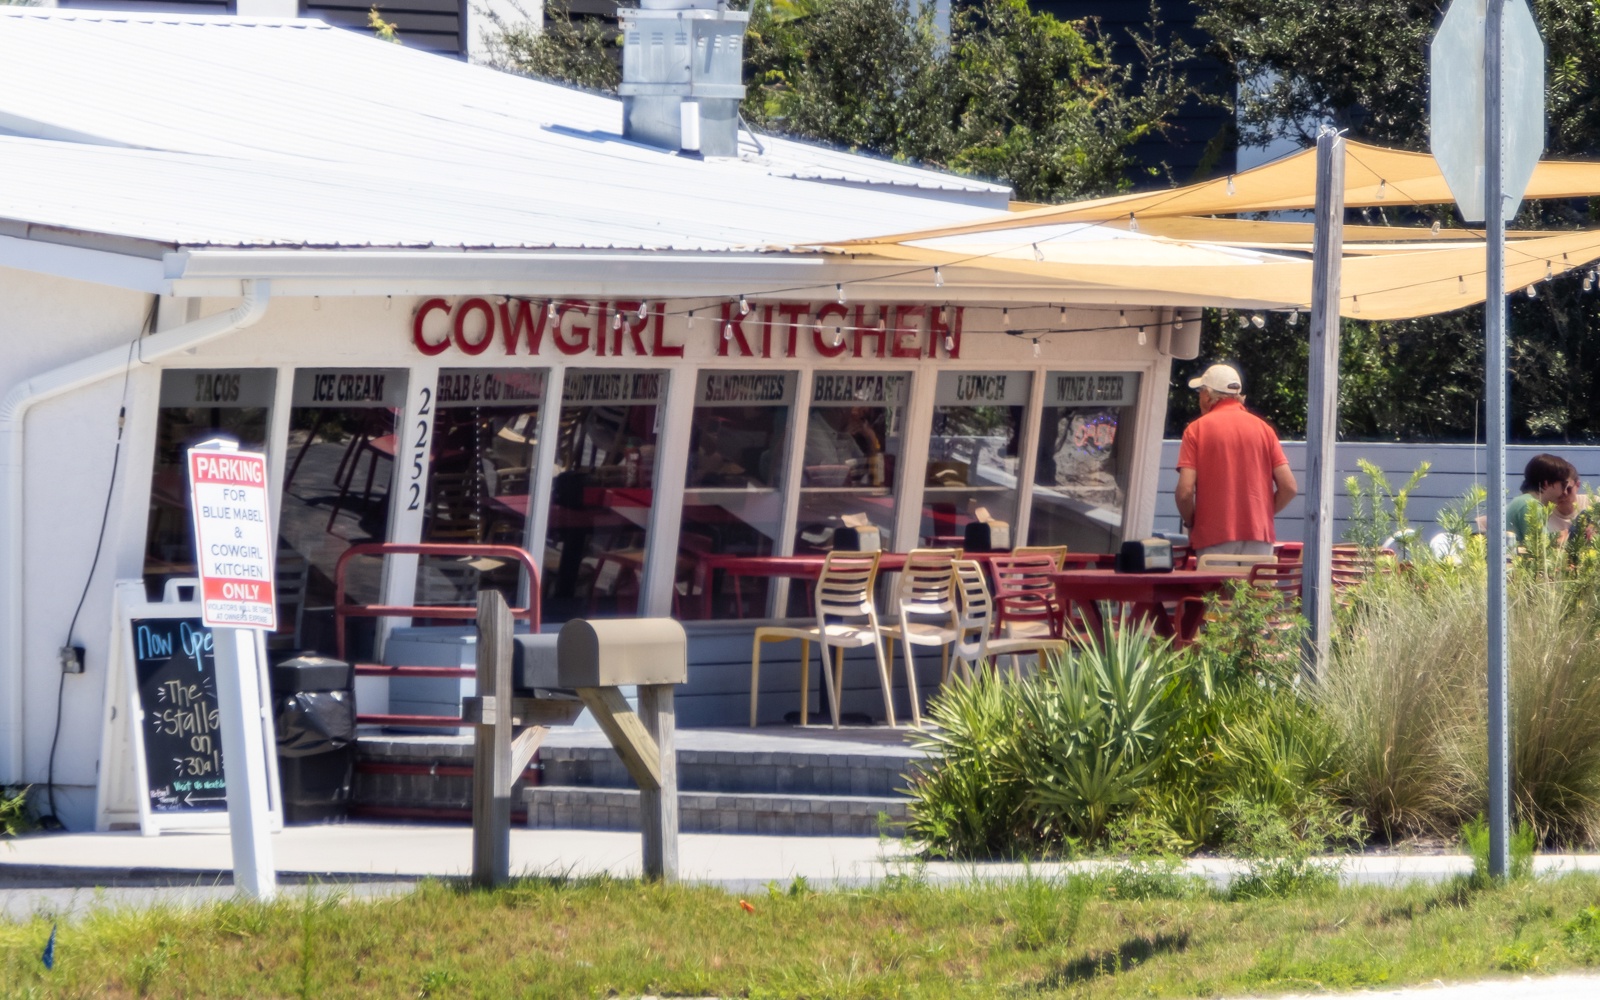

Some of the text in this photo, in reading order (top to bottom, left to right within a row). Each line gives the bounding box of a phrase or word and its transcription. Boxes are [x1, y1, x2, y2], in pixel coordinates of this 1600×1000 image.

[413, 297, 965, 360] COWGIRL KITCHEN
[195, 373, 241, 402] TACOS
[313, 374, 386, 401] ICE CREAM
[471, 374, 482, 401] &
[484, 374, 502, 401] GO
[705, 374, 785, 401] SANDWICHES
[815, 375, 905, 401] BREAKFAST
[956, 375, 1007, 400] LUNCH
[1057, 376, 1124, 401] WINE & BEER
[407, 387, 431, 511] 2252
[196, 457, 262, 483] PARKING
[223, 488, 246, 502] FOR
[203, 506, 263, 522] BLUE MABEL
[234, 526, 242, 539] &
[211, 543, 263, 560] COWGIRL
[214, 562, 263, 578] KITCHEN
[222, 582, 260, 601] ONLY
[180, 621, 214, 672] Ope
[164, 680, 203, 707] The
[163, 701, 220, 738] Stalls
[190, 735, 212, 756] on
